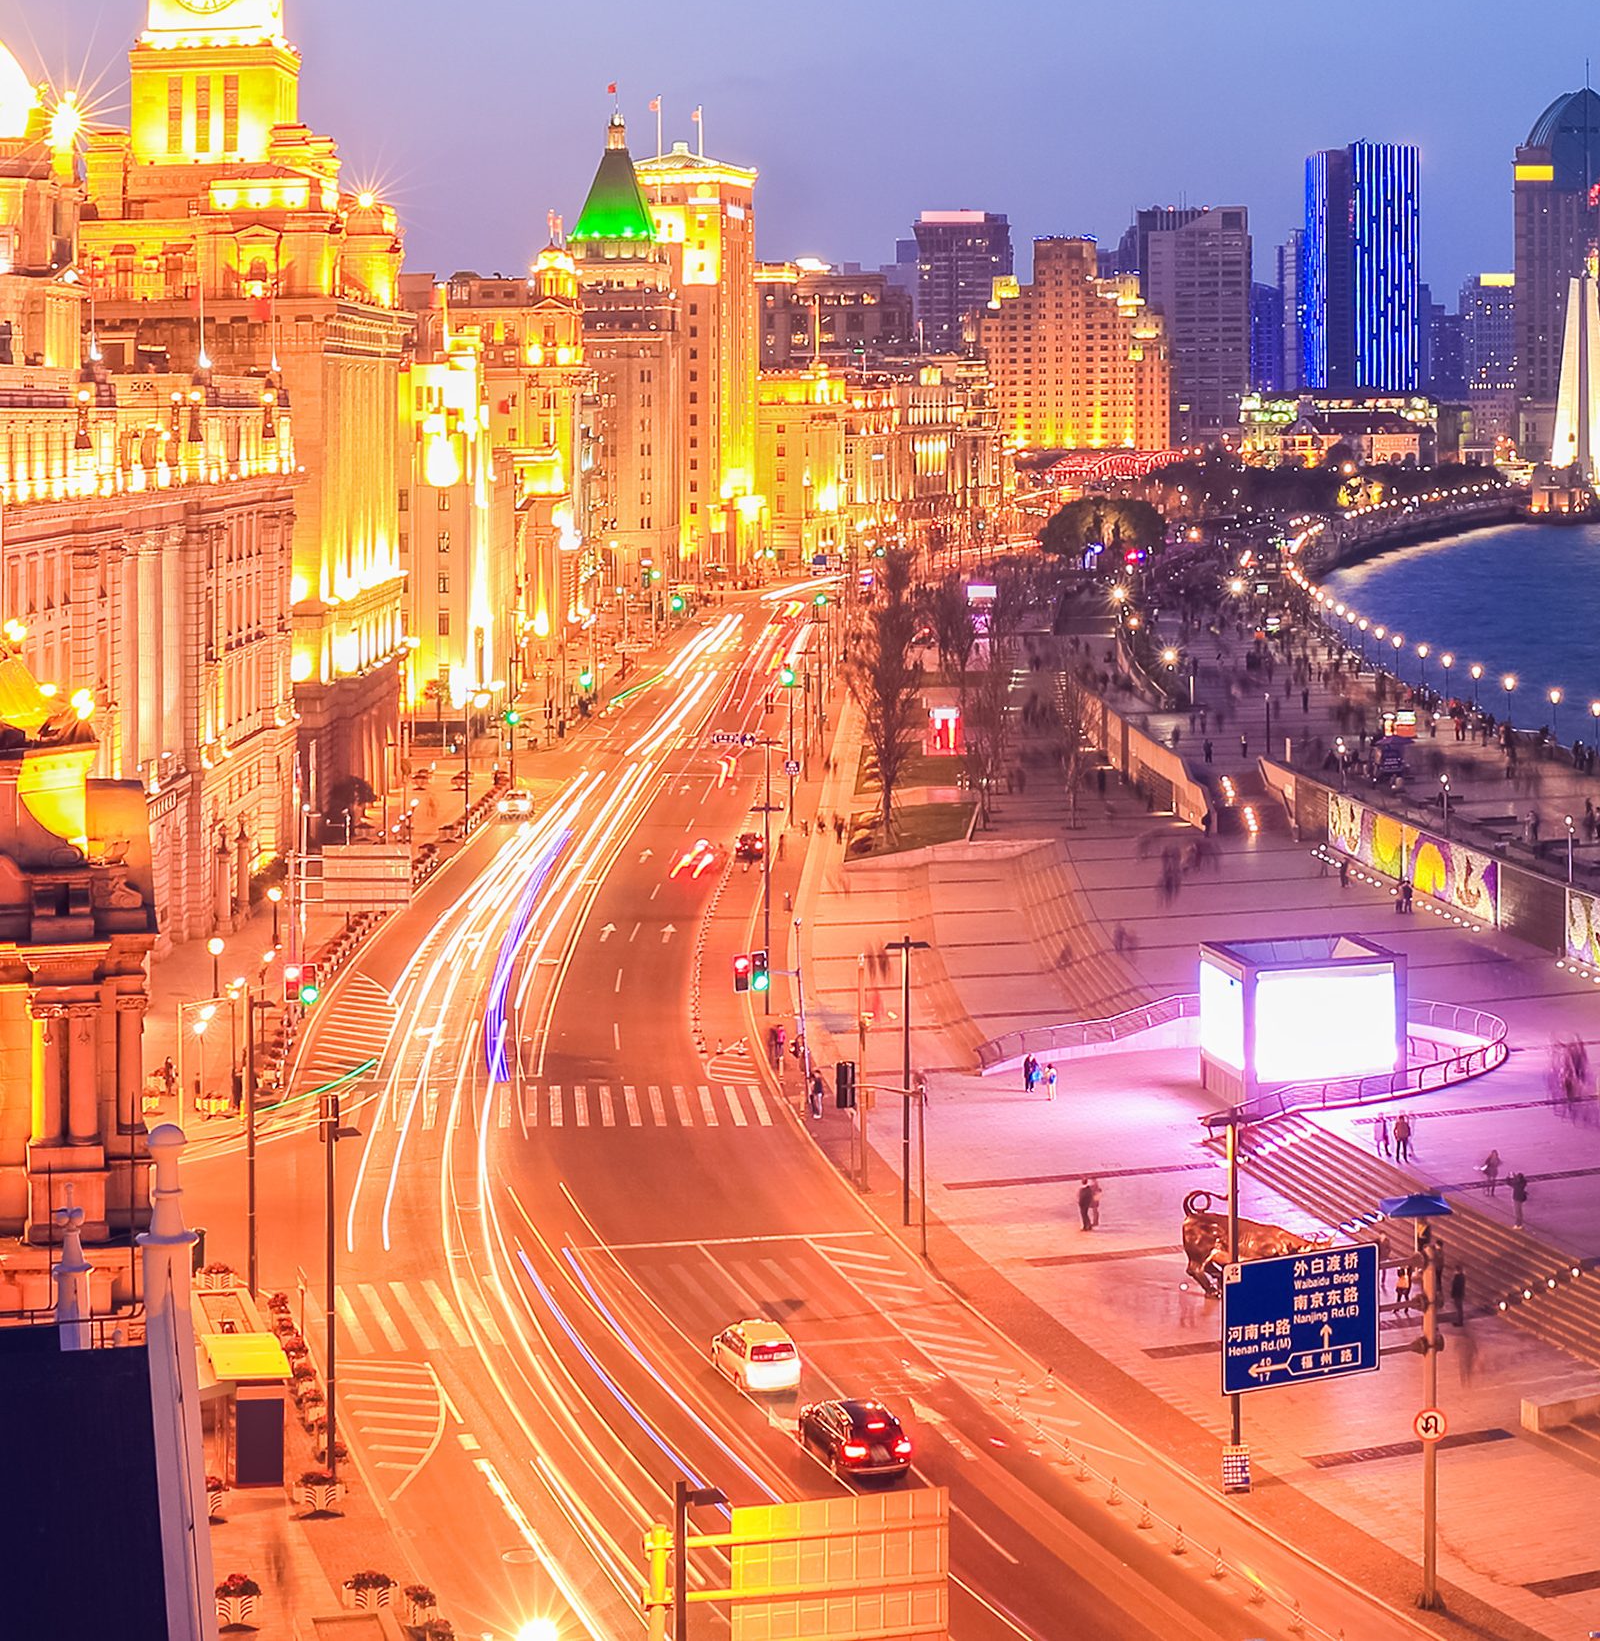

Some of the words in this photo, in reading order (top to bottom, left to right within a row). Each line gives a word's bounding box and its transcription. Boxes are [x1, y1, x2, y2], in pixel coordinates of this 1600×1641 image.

[1294, 1252, 1359, 1277] 外白渡桥
[1294, 1277, 1330, 1290] Waibaidu
[1333, 1273, 1359, 1284] Bridge
[1294, 1286, 1359, 1311] 南京东路
[1294, 1311, 1328, 1324] Nanjing
[1331, 1305, 1359, 1319] Rd.(E)
[1228, 1318, 1291, 1343] 河南中路
[1228, 1343, 1258, 1357] Henan
[1261, 1337, 1292, 1353] Rd.(M)
[1301, 1349, 1353, 1369] 福州路
[1259, 1372, 1271, 1382] 17
